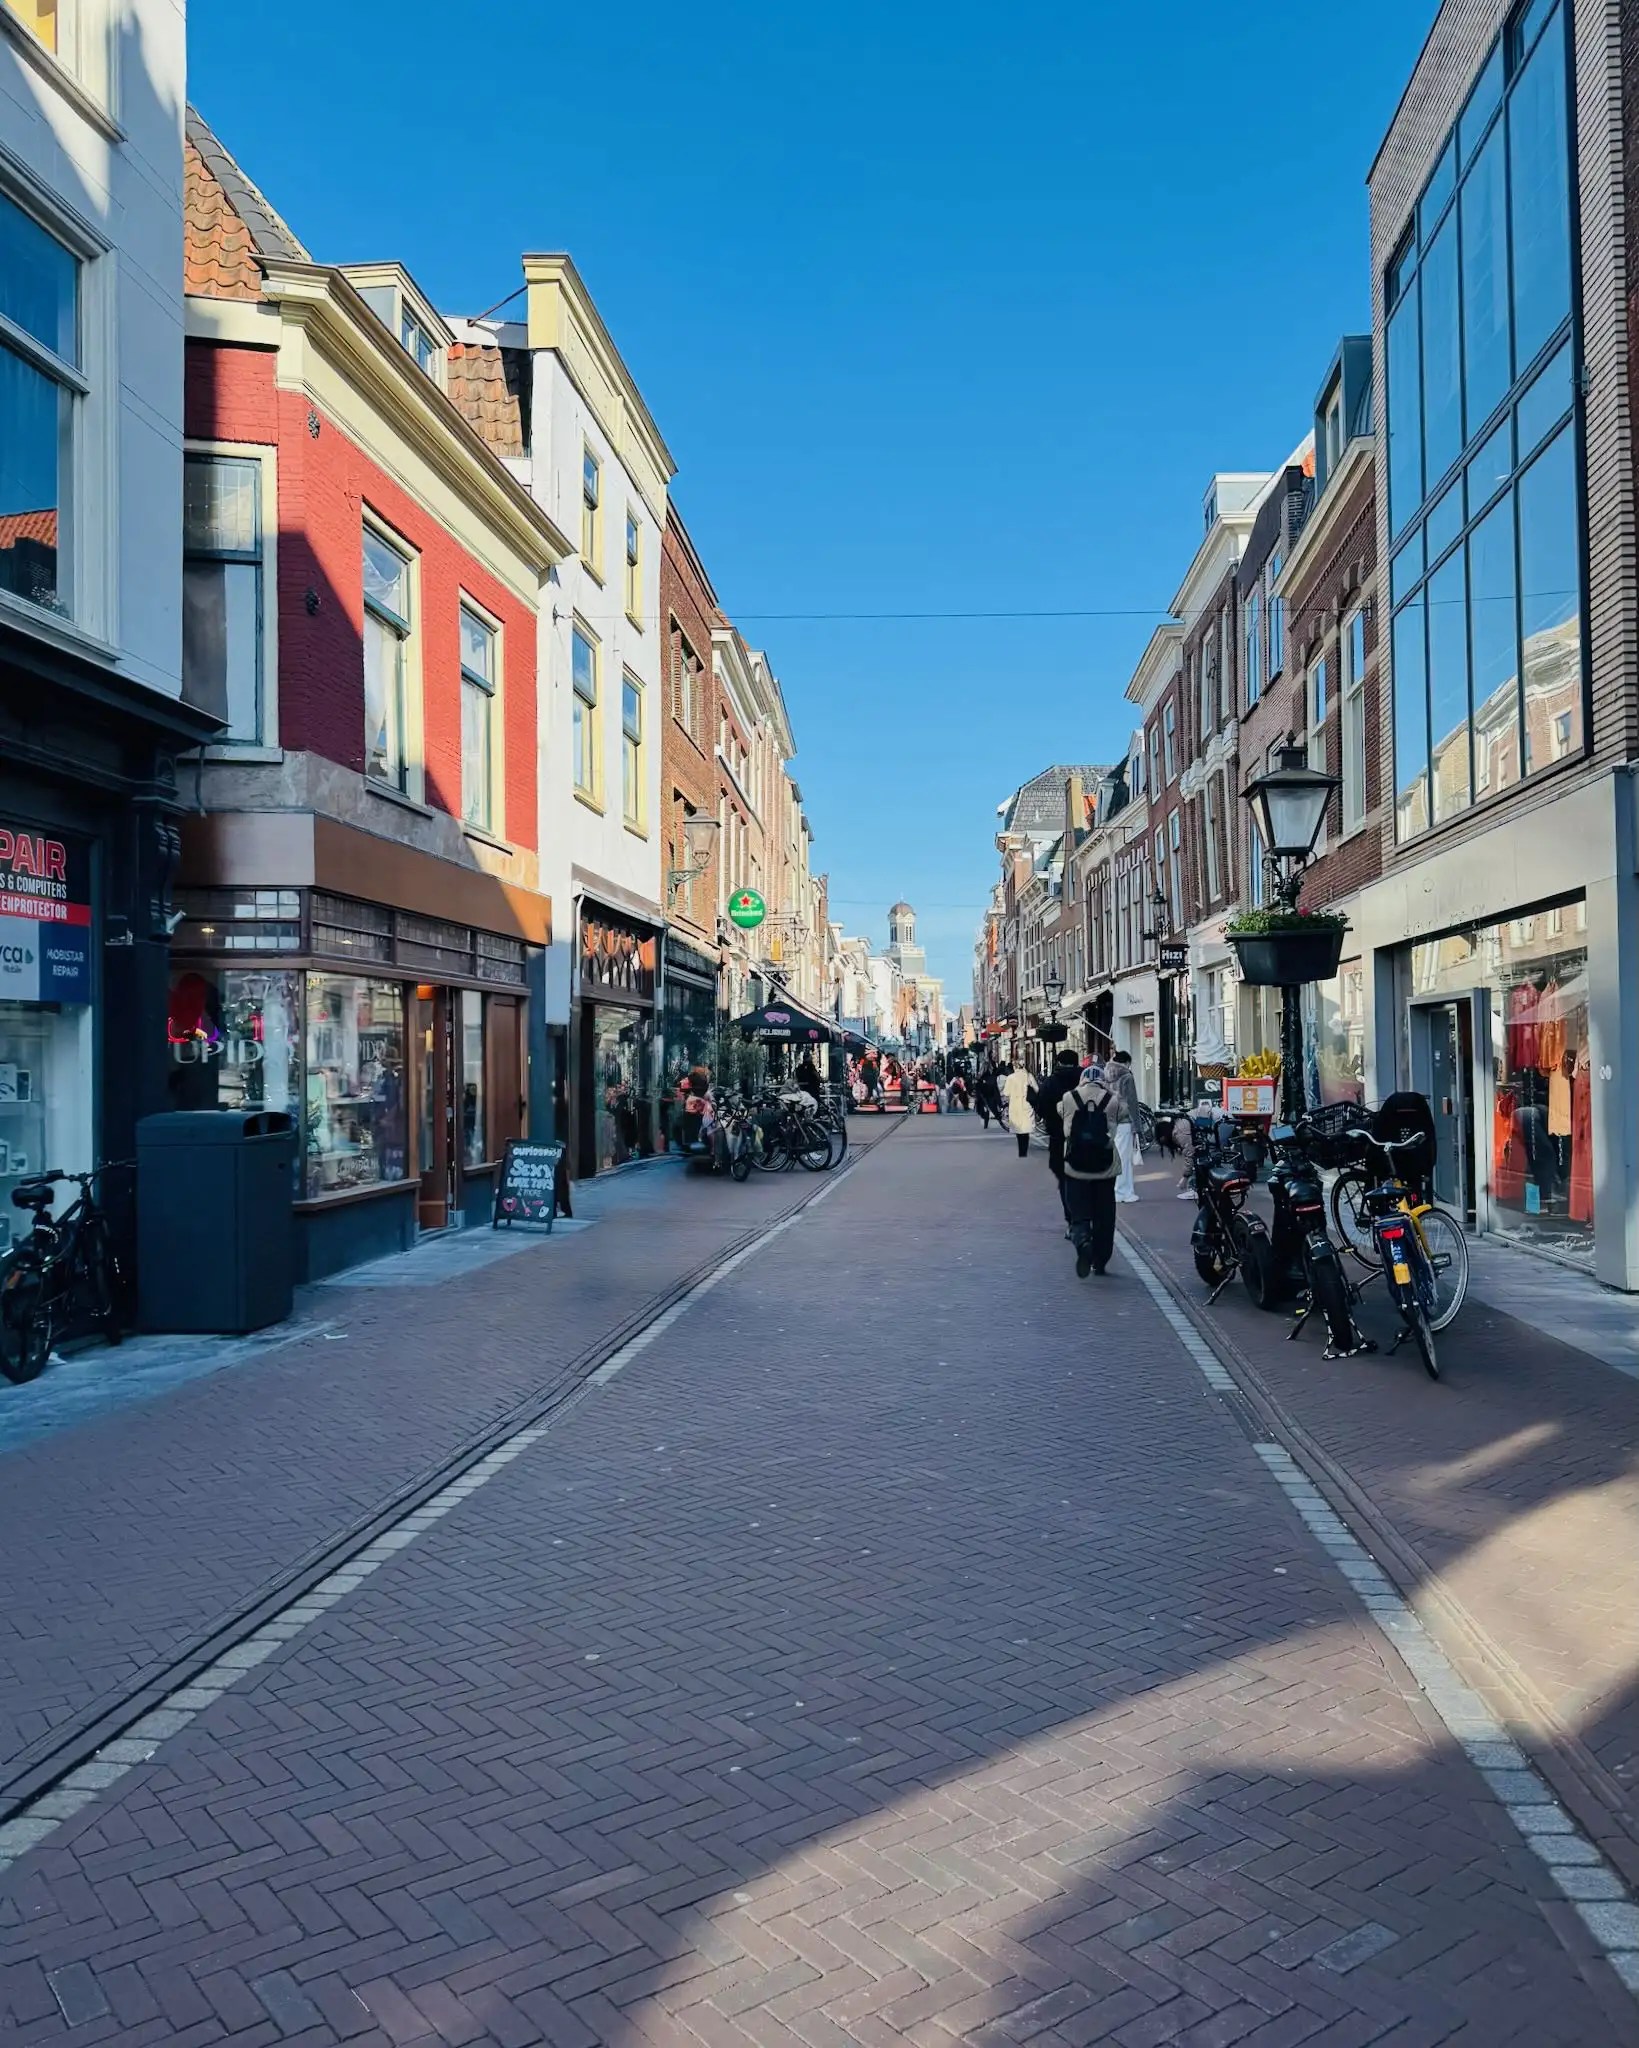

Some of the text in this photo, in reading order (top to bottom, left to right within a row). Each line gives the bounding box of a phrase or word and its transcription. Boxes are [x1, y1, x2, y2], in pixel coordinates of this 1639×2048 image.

[7, 874, 15, 890] &
[16, 875, 67, 899] COMPUTERS
[0, 895, 68, 920] ENPROTECTOR
[52, 964, 79, 977] REPAIR
